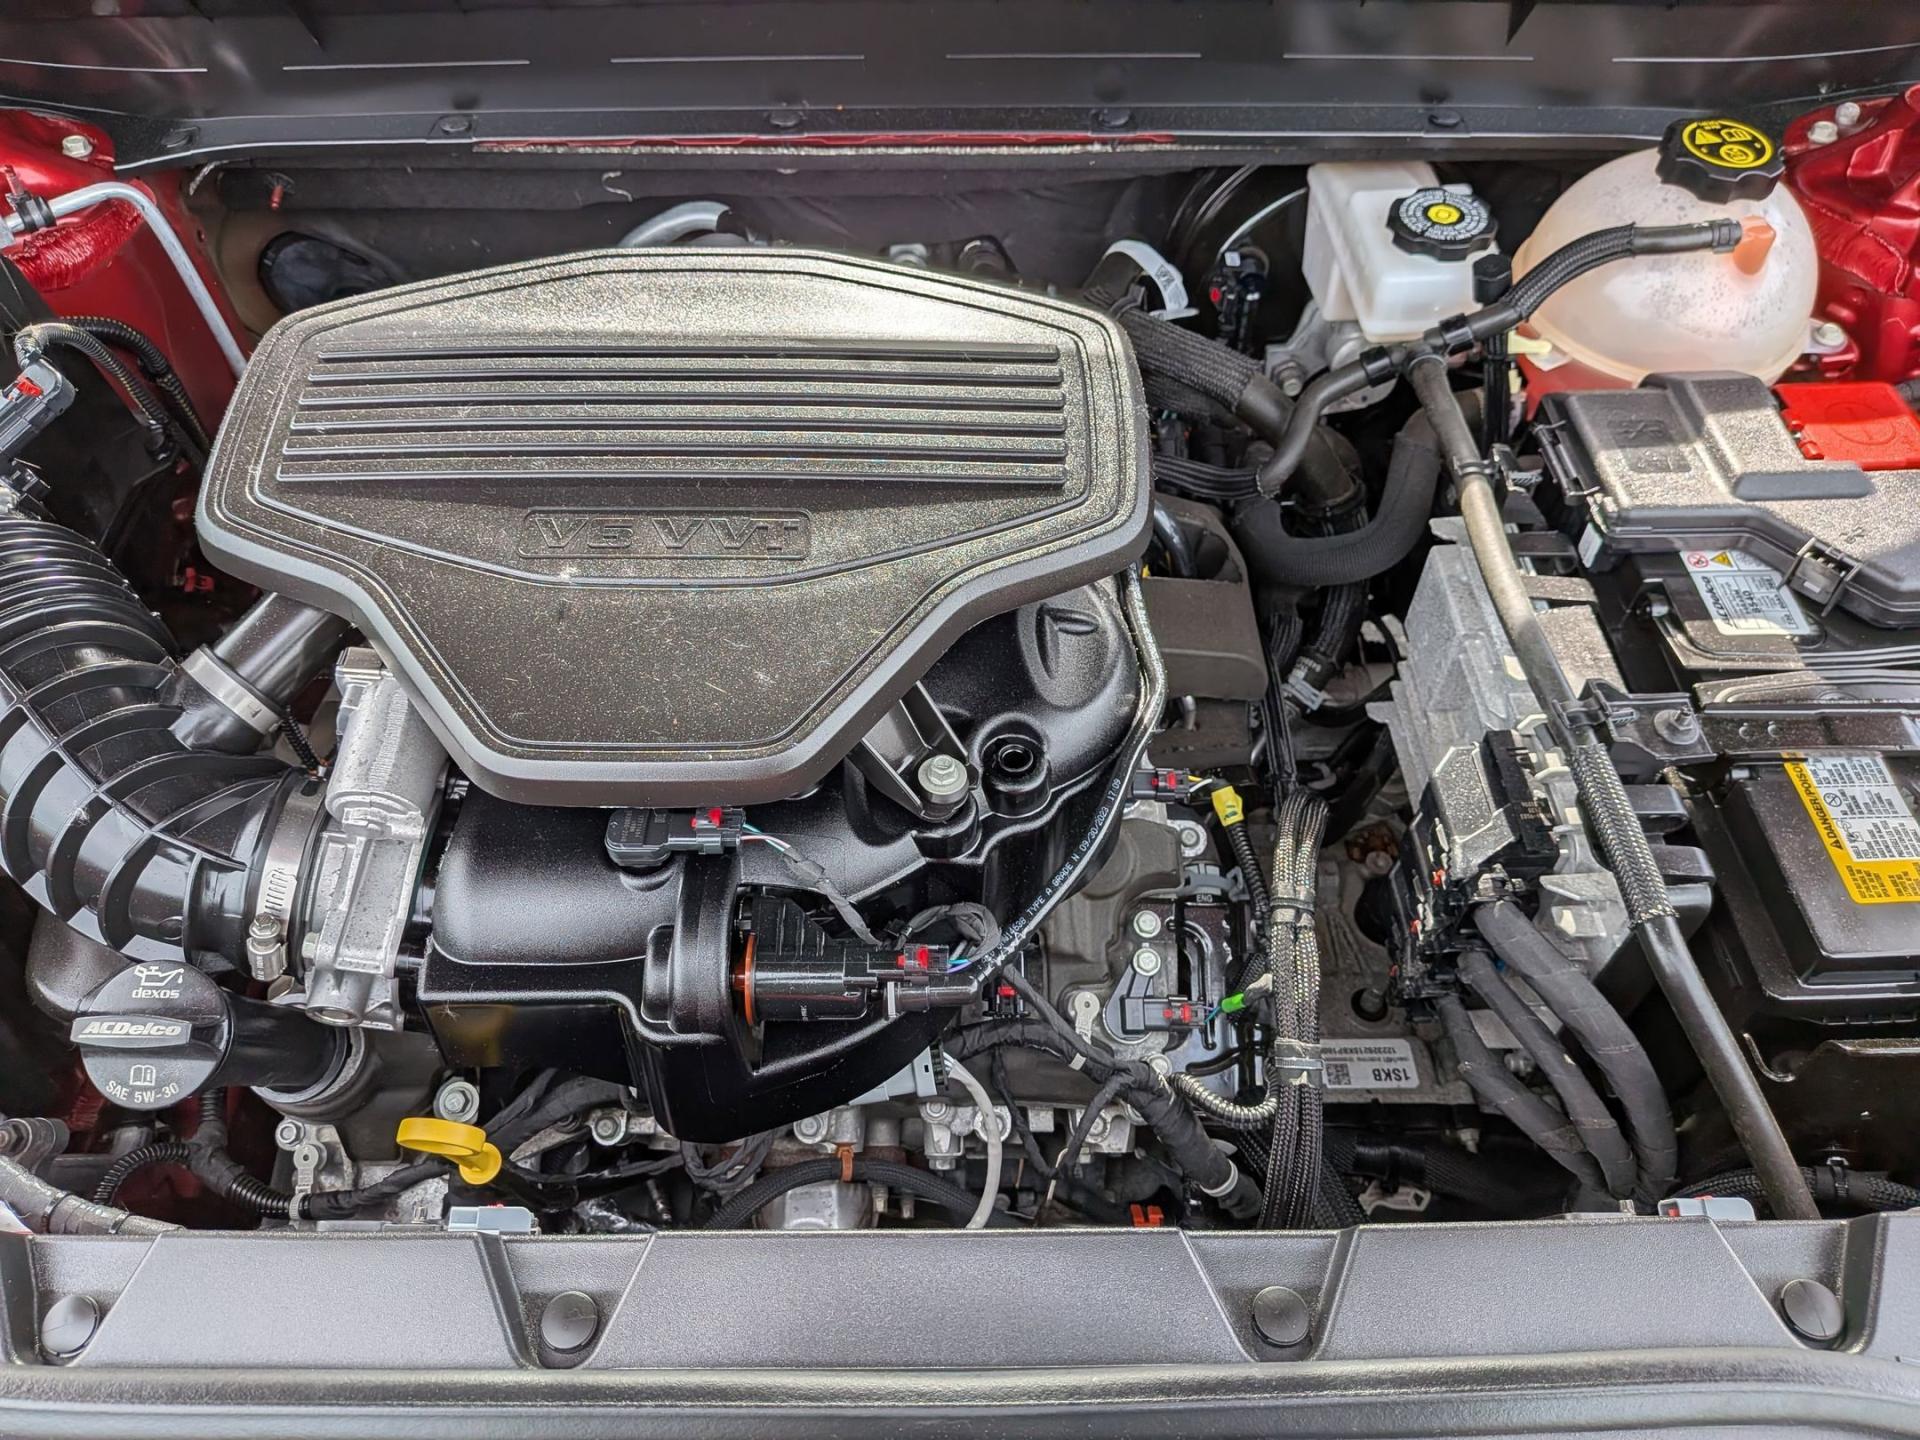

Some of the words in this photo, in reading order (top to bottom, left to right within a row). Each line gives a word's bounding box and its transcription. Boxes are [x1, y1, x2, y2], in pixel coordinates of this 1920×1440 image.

[534, 517, 634, 549] V6
[651, 517, 800, 550] VVT
[1025, 895, 1046, 917] TYPE
[1045, 887, 1054, 896] A
[1051, 861, 1075, 887] GRADE
[1071, 853, 1081, 862] N
[1079, 806, 1110, 853] 09/30/2023
[131, 986, 181, 999] dexos
[81, 1021, 182, 1036] ACDelco
[1371, 1067, 1412, 1082] 1SKB
[105, 1080, 130, 1101] SAE
[133, 1081, 180, 1104] 5W-30
